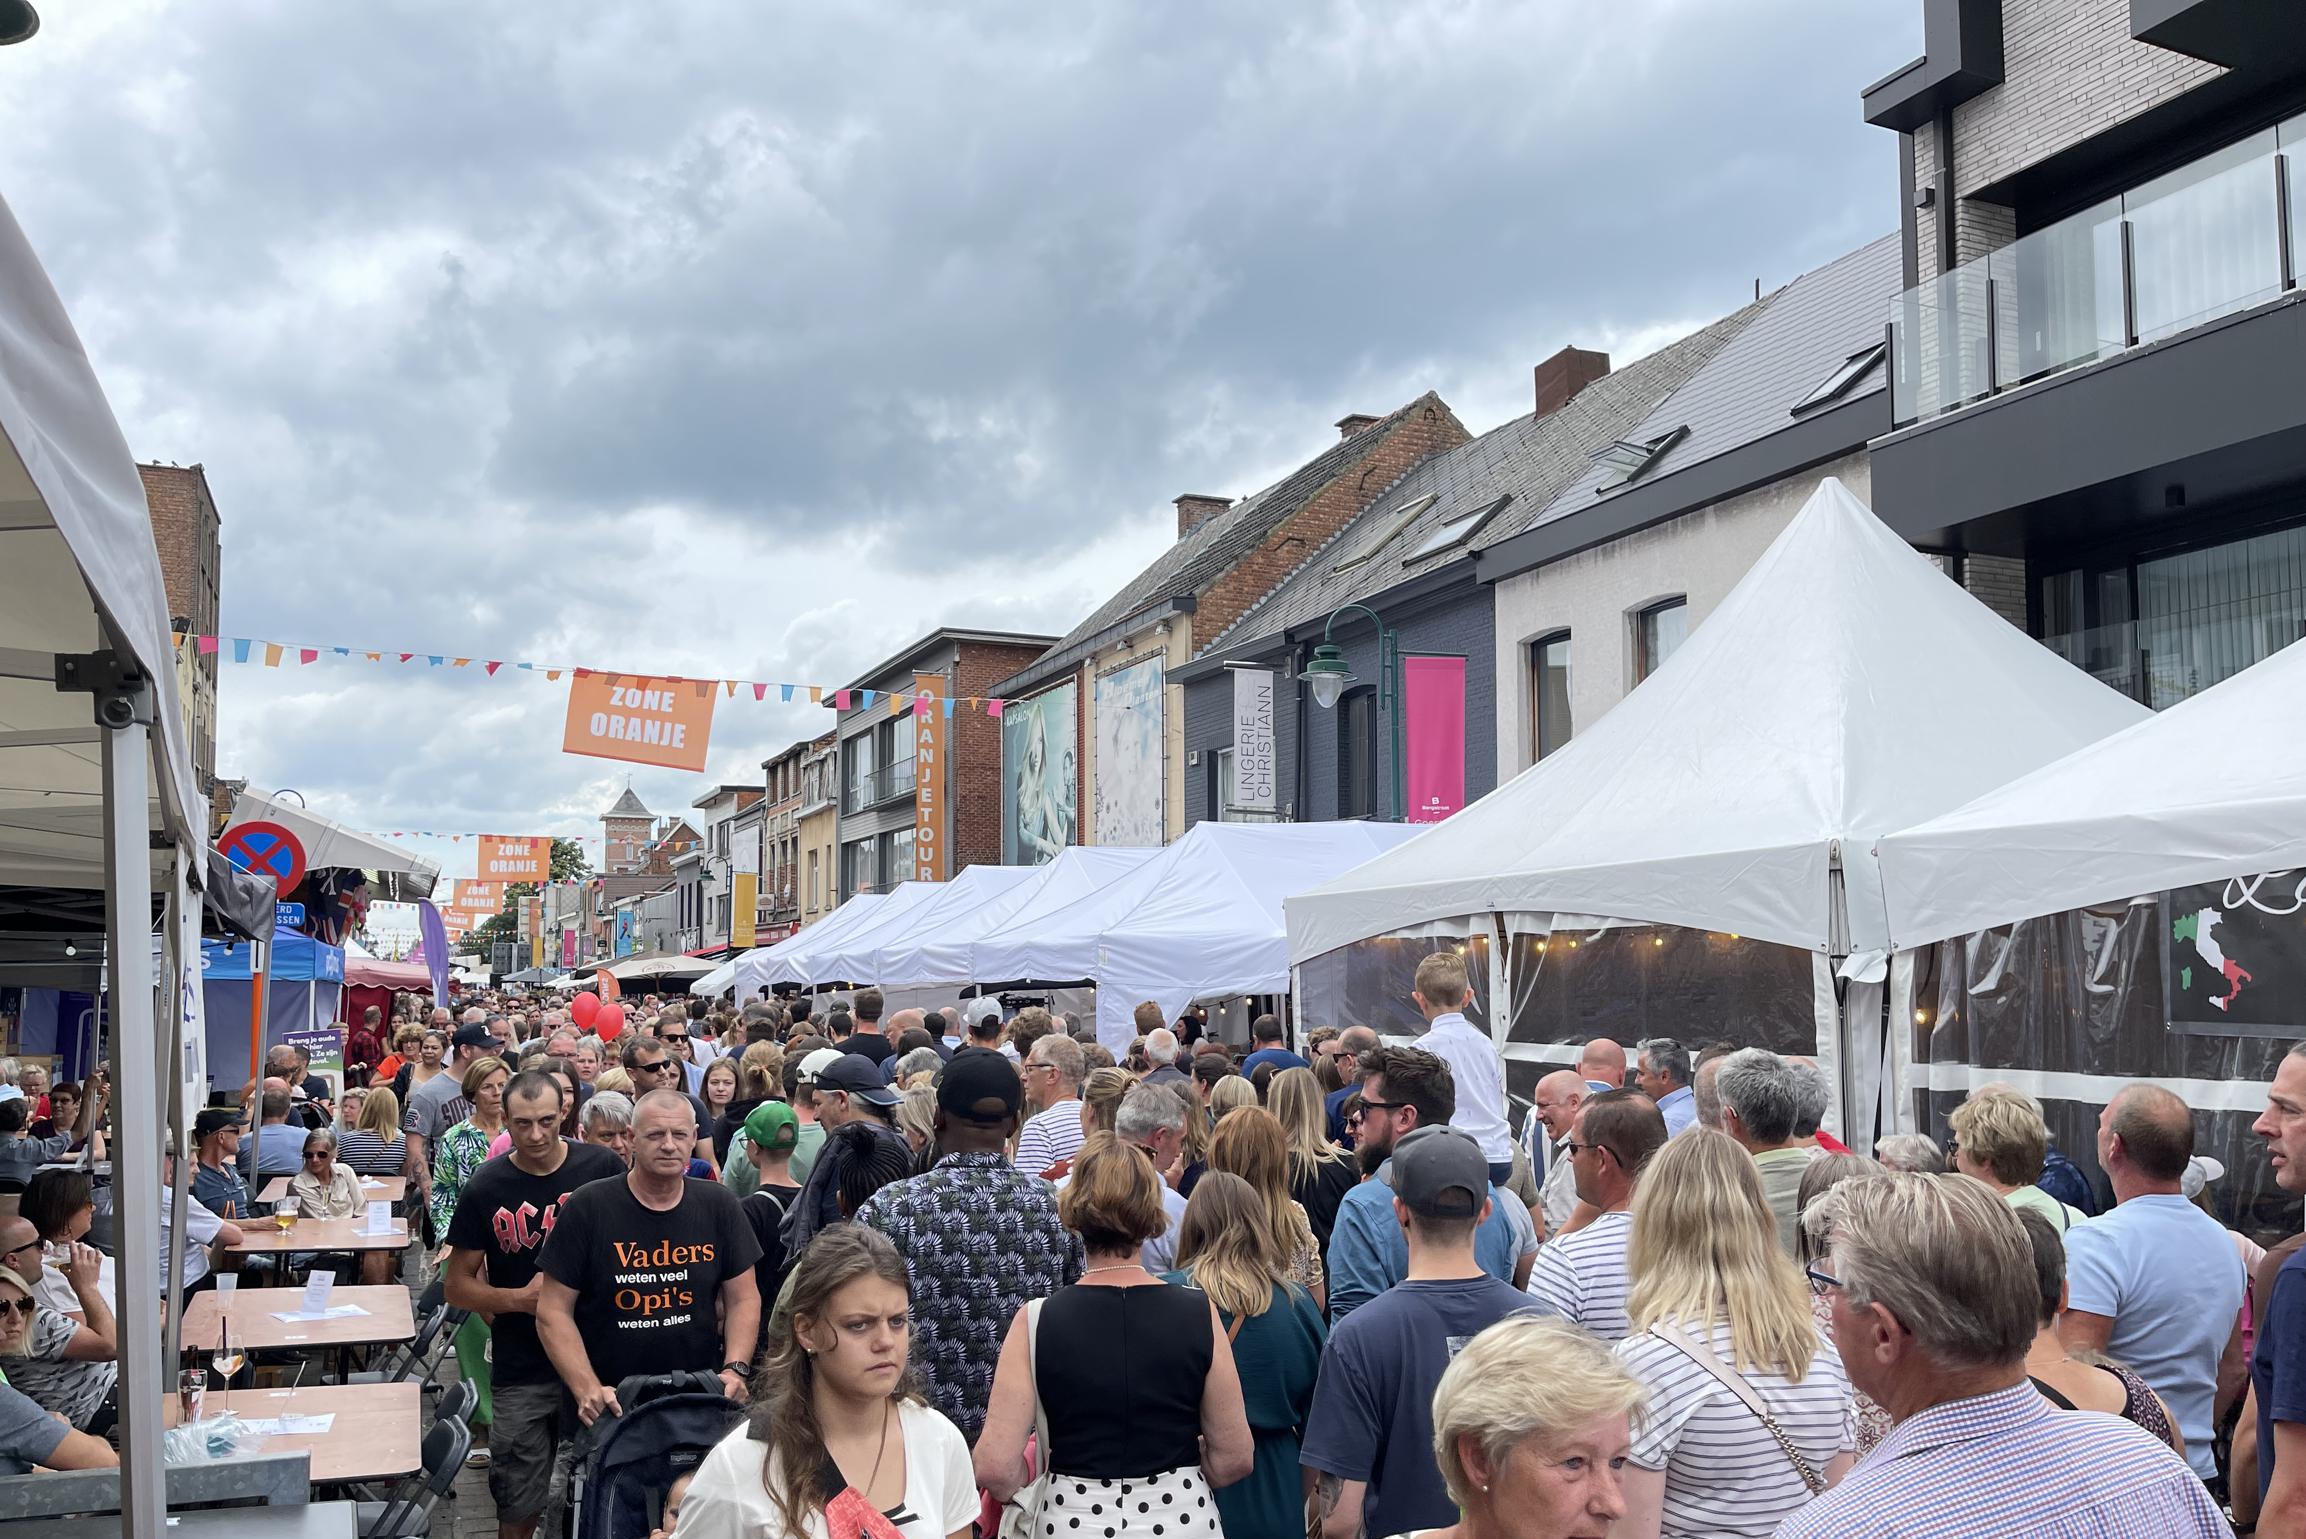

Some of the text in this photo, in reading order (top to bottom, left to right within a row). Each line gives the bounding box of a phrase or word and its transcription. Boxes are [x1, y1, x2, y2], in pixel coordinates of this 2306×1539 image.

[609, 687, 675, 712] ZONE
[590, 712, 686, 749] ORANJE
[1257, 685, 1272, 798] CHRISTIANN
[1240, 715, 1255, 801] LINGERIE
[919, 689, 935, 881] ORANJETOUR
[498, 844, 530, 856] ZONE
[489, 860, 537, 872] ORANJE
[461, 898, 496, 908] ORANJE
[467, 886, 490, 896] ZONE
[613, 1240, 715, 1268] Vaders
[615, 1269, 688, 1284] weten veel
[615, 1286, 693, 1316] Opi's
[618, 1314, 691, 1329] weten alles
